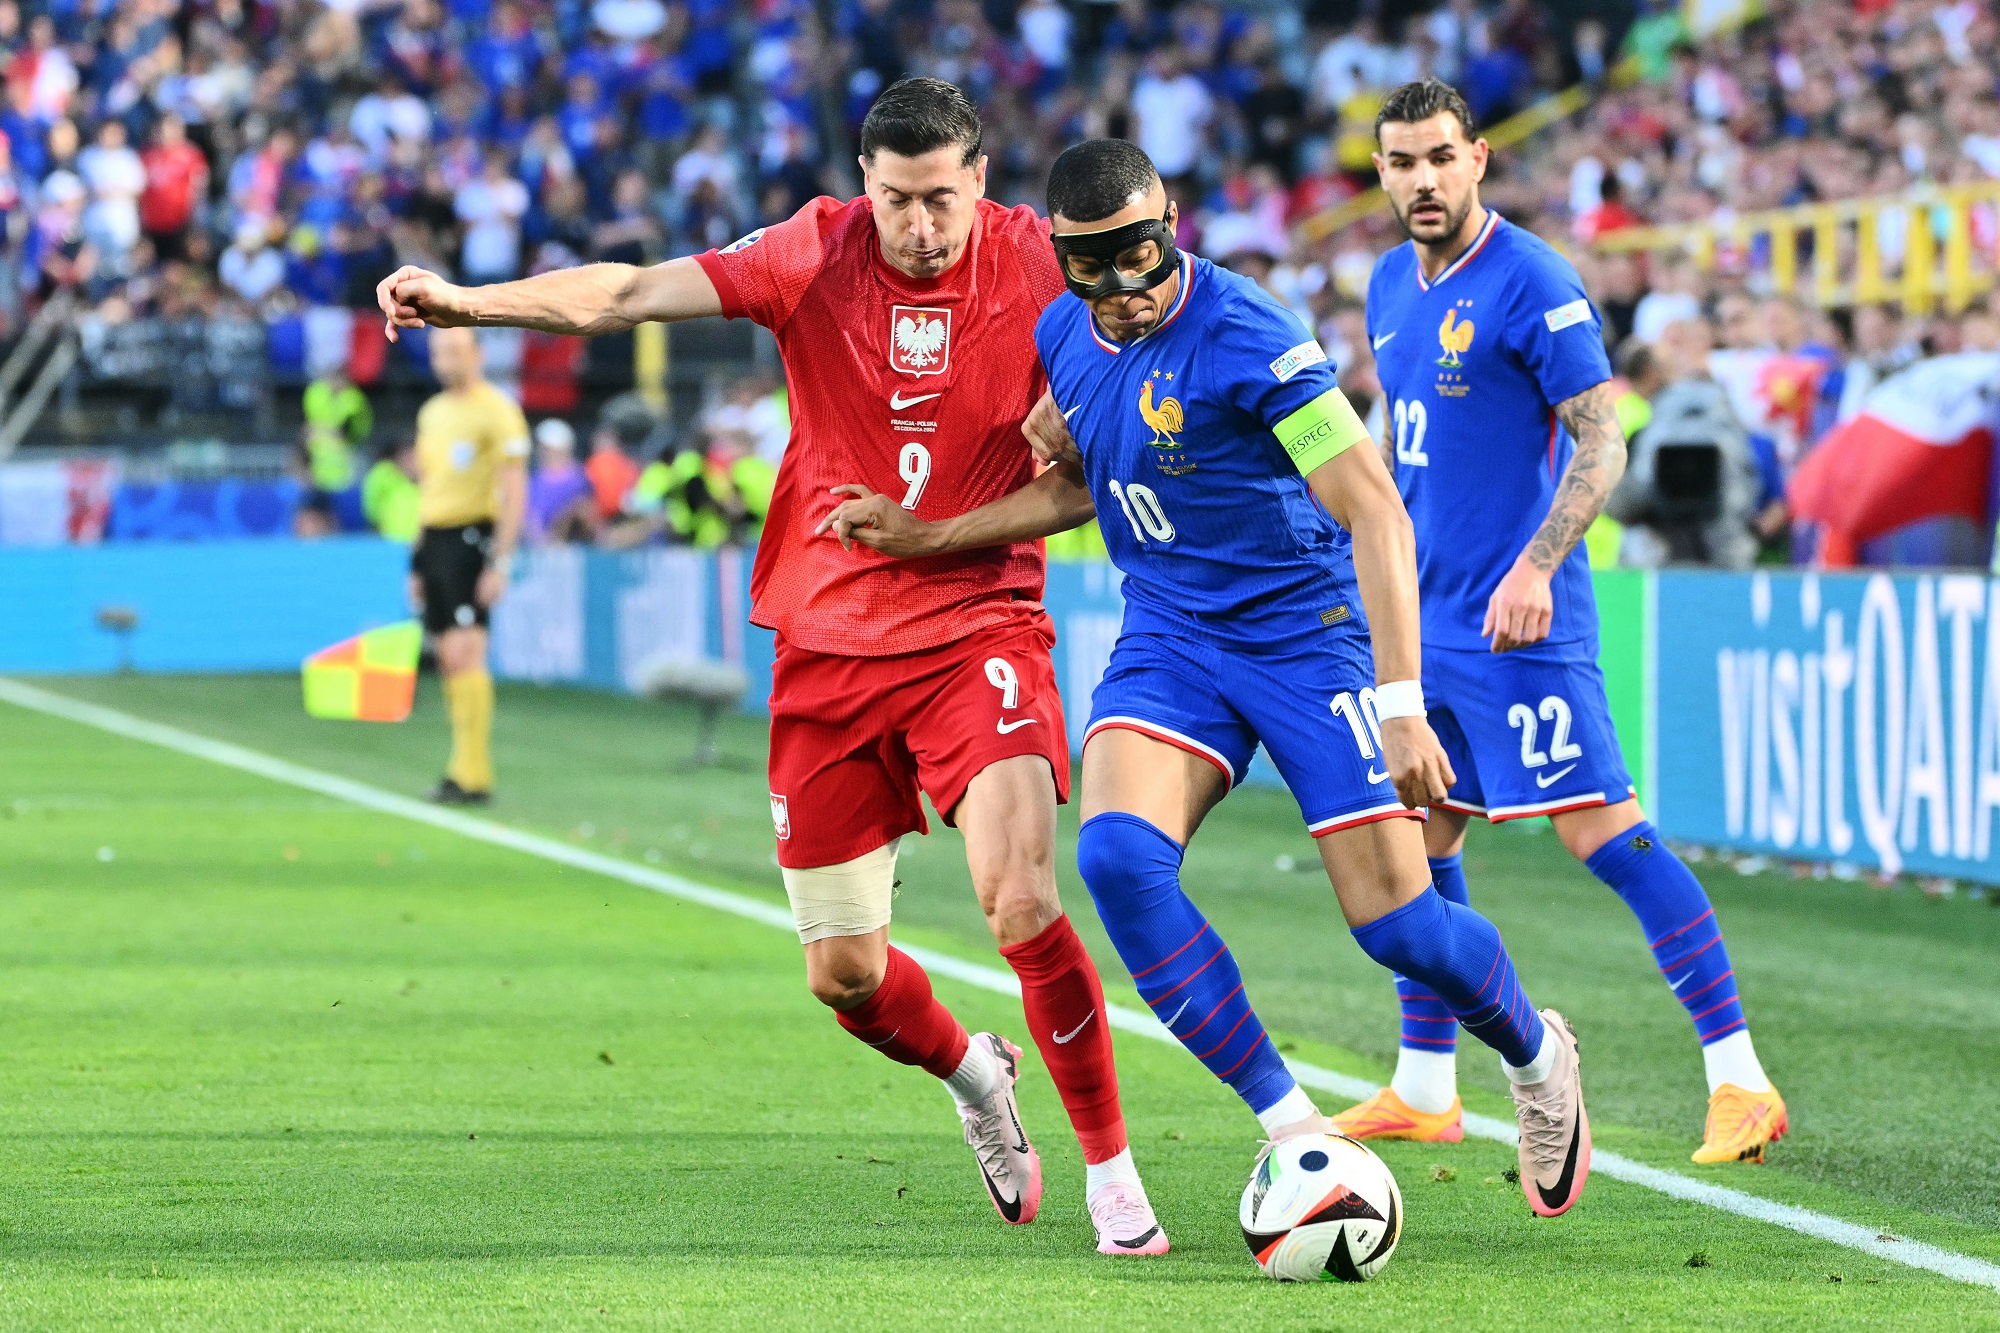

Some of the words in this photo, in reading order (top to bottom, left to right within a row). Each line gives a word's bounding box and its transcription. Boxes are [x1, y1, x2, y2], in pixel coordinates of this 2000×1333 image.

[1288, 421, 1332, 458] RESPECT
[1394, 399, 1428, 467] 22
[899, 442, 931, 510] 9
[1108, 479, 1176, 544] 10
[984, 657, 1019, 709] 9
[1507, 695, 1583, 769] 22
